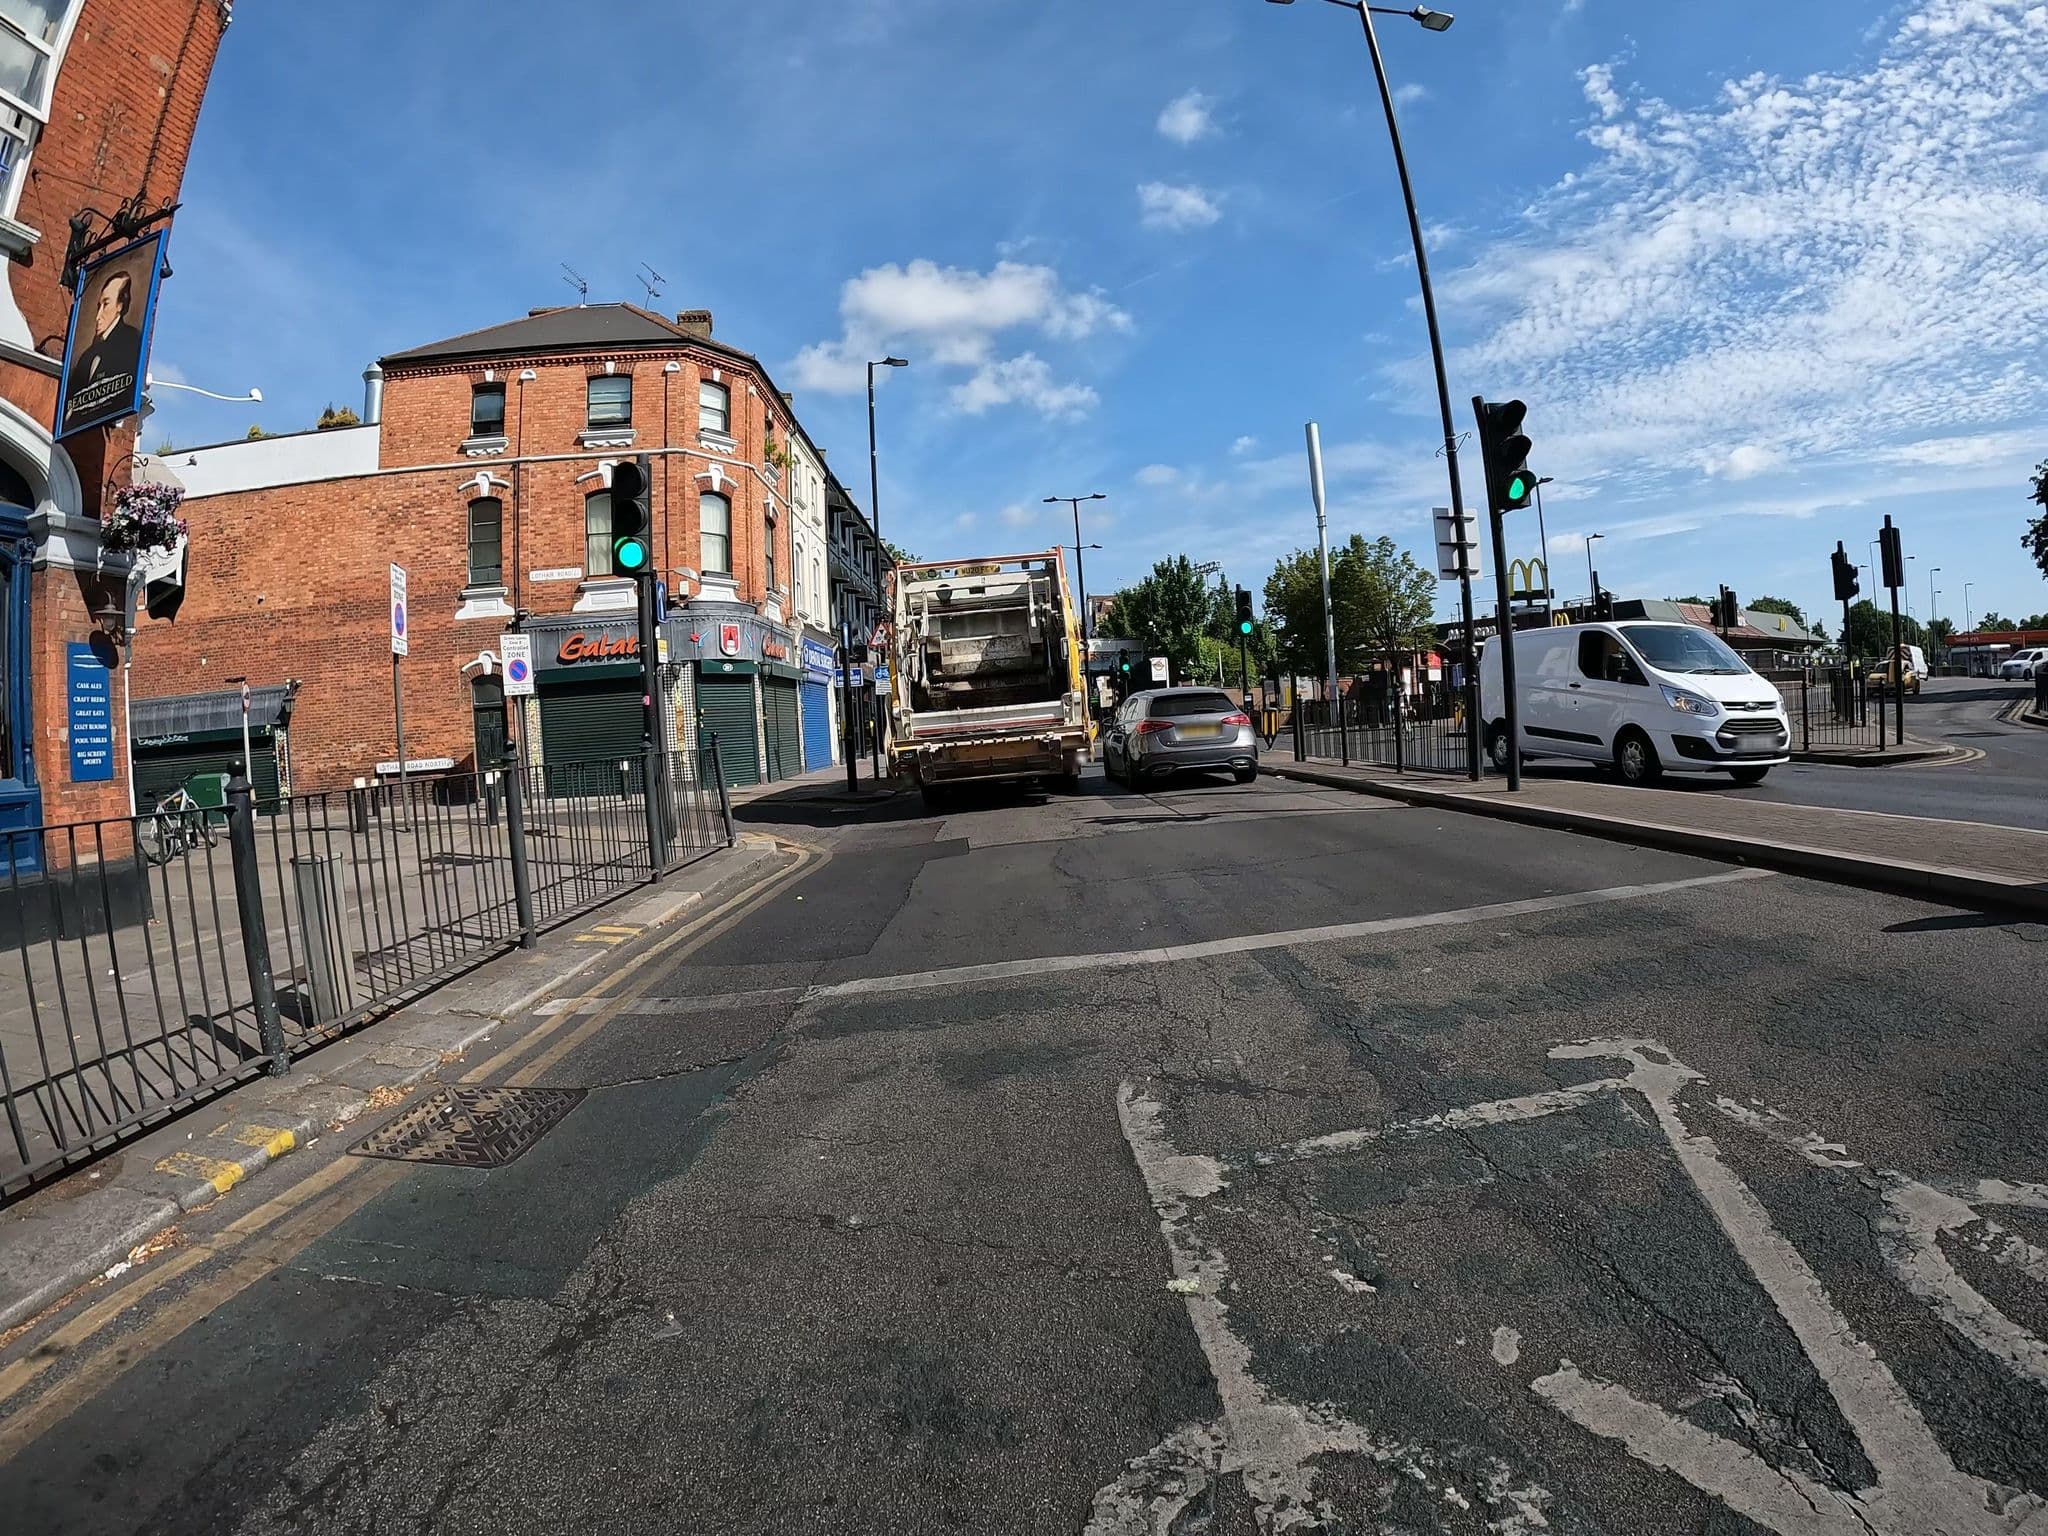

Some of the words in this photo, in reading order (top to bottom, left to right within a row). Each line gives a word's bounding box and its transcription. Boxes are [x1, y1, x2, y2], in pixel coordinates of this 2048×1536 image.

[67, 375, 133, 410] BEACONSFIELD
[560, 632, 639, 660] Galat
[87, 750, 106, 758] SCREEN
[407, 761, 423, 769] ROAD
[424, 759, 446, 768] NORTH
